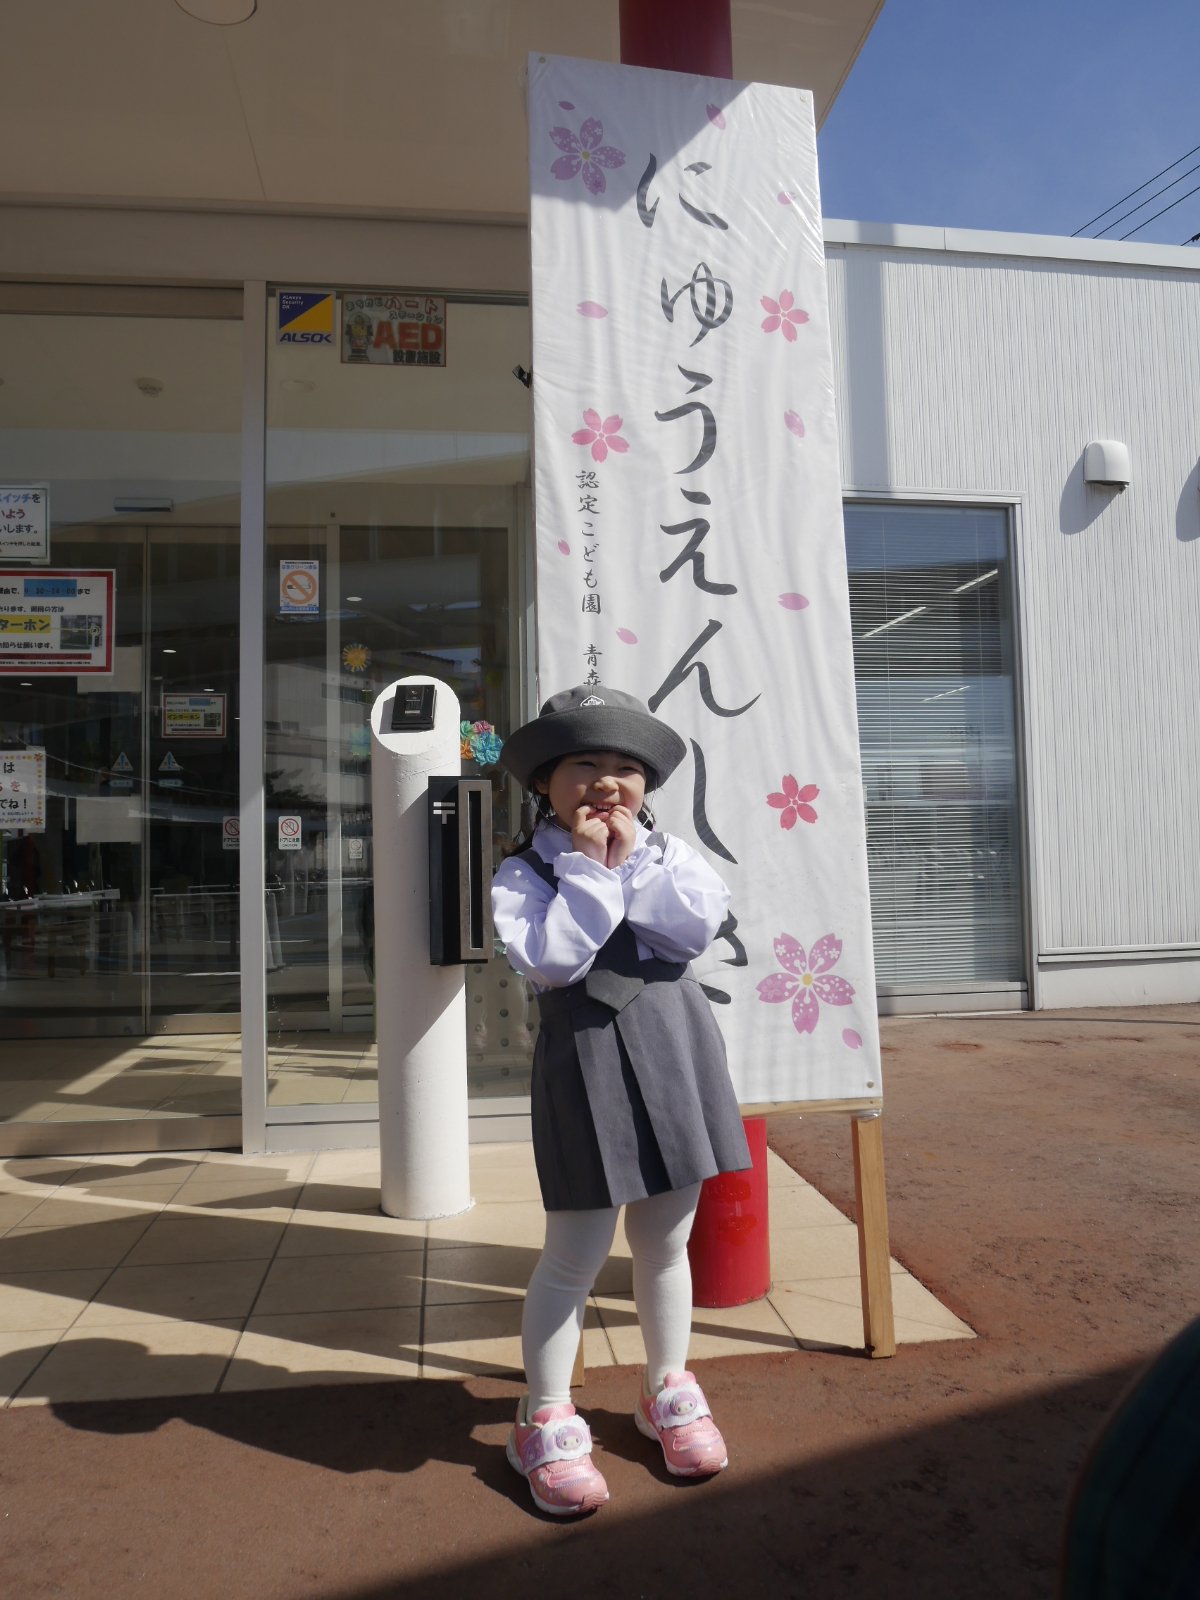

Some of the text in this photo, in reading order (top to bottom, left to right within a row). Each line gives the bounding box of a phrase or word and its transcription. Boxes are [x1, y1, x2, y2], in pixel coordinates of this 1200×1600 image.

[280, 333, 331, 343] ALSOK
[373, 320, 443, 350] AED
[0, 493, 40, 503] イッチを
[575, 470, 602, 614] 認定こども園
[4, 762, 15, 773] は
